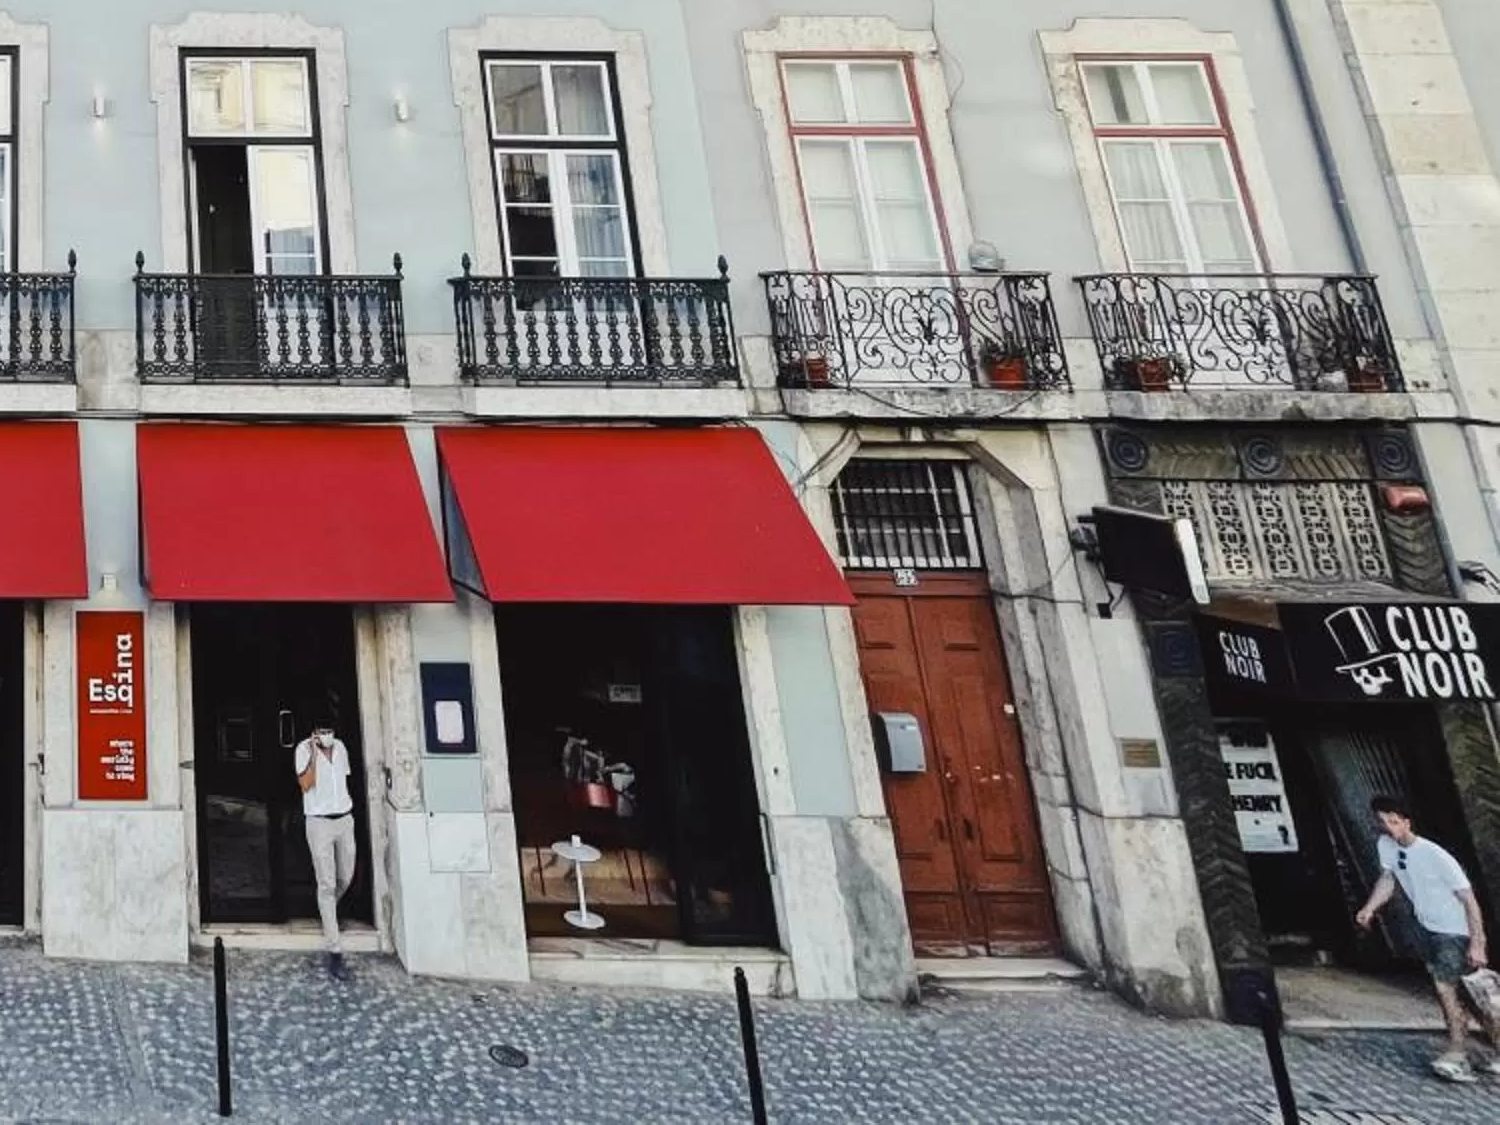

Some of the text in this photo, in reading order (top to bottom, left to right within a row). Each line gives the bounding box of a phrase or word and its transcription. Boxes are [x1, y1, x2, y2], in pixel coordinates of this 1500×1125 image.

[1219, 631, 1261, 660] CLUB
[1386, 606, 1477, 651] CLUB
[1224, 653, 1267, 683] NOIR
[1398, 652, 1495, 698] NOIR
